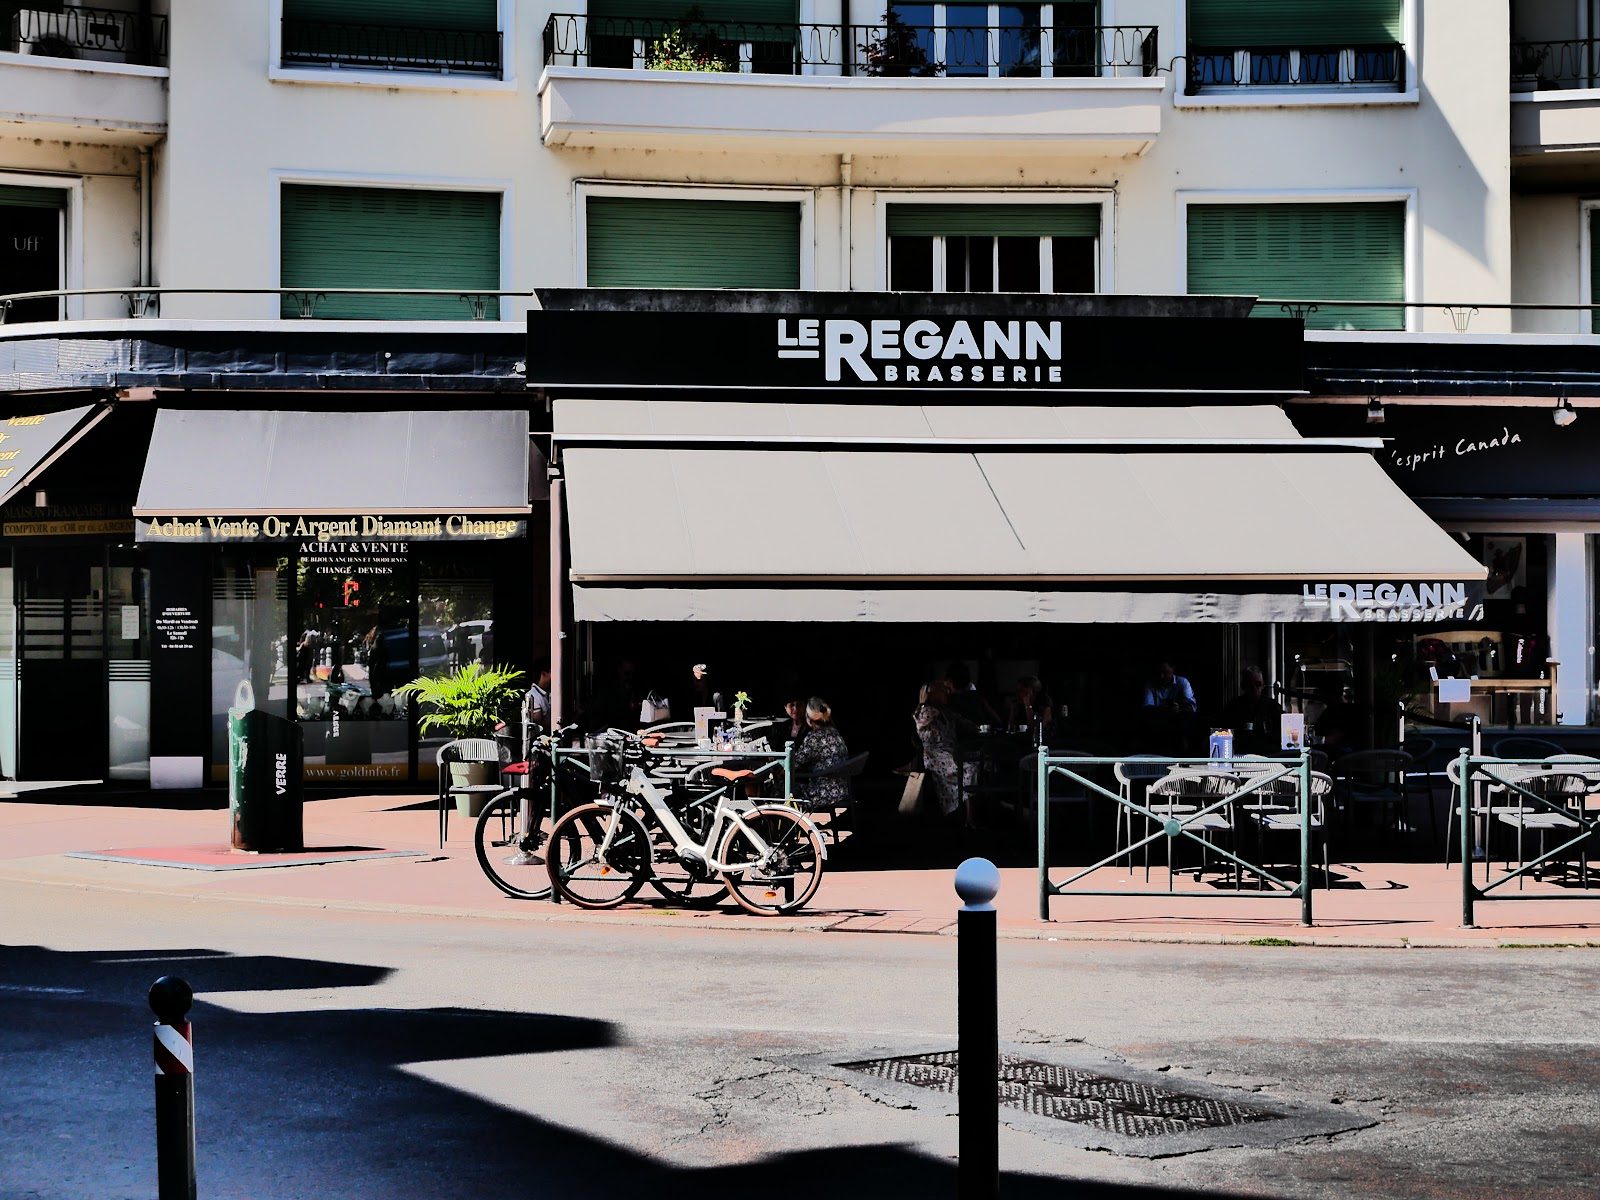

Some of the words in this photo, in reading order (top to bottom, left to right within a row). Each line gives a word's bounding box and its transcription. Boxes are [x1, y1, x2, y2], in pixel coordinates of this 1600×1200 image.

[778, 319, 819, 346] LE
[825, 320, 1062, 381] REGANN
[885, 365, 1062, 382] BRASSERIE
[1455, 427, 1521, 455] Canada
[4, 524, 48, 535] COMPTOIR
[147, 517, 203, 537] Achat
[207, 517, 259, 537] Vente
[263, 516, 290, 537] Or
[293, 516, 358, 541] Argent
[361, 515, 442, 537] Diamant
[446, 515, 518, 538] Change
[299, 542, 347, 553] ACHAT
[349, 542, 360, 553] &
[362, 542, 409, 553] VENTE
[1303, 584, 1328, 600] LE
[1330, 583, 1465, 619] REGANN
[1364, 608, 1465, 619] BRASSERIE
[275, 753, 287, 795] VERRE
[306, 766, 401, 778] www.goldinfo.fr
